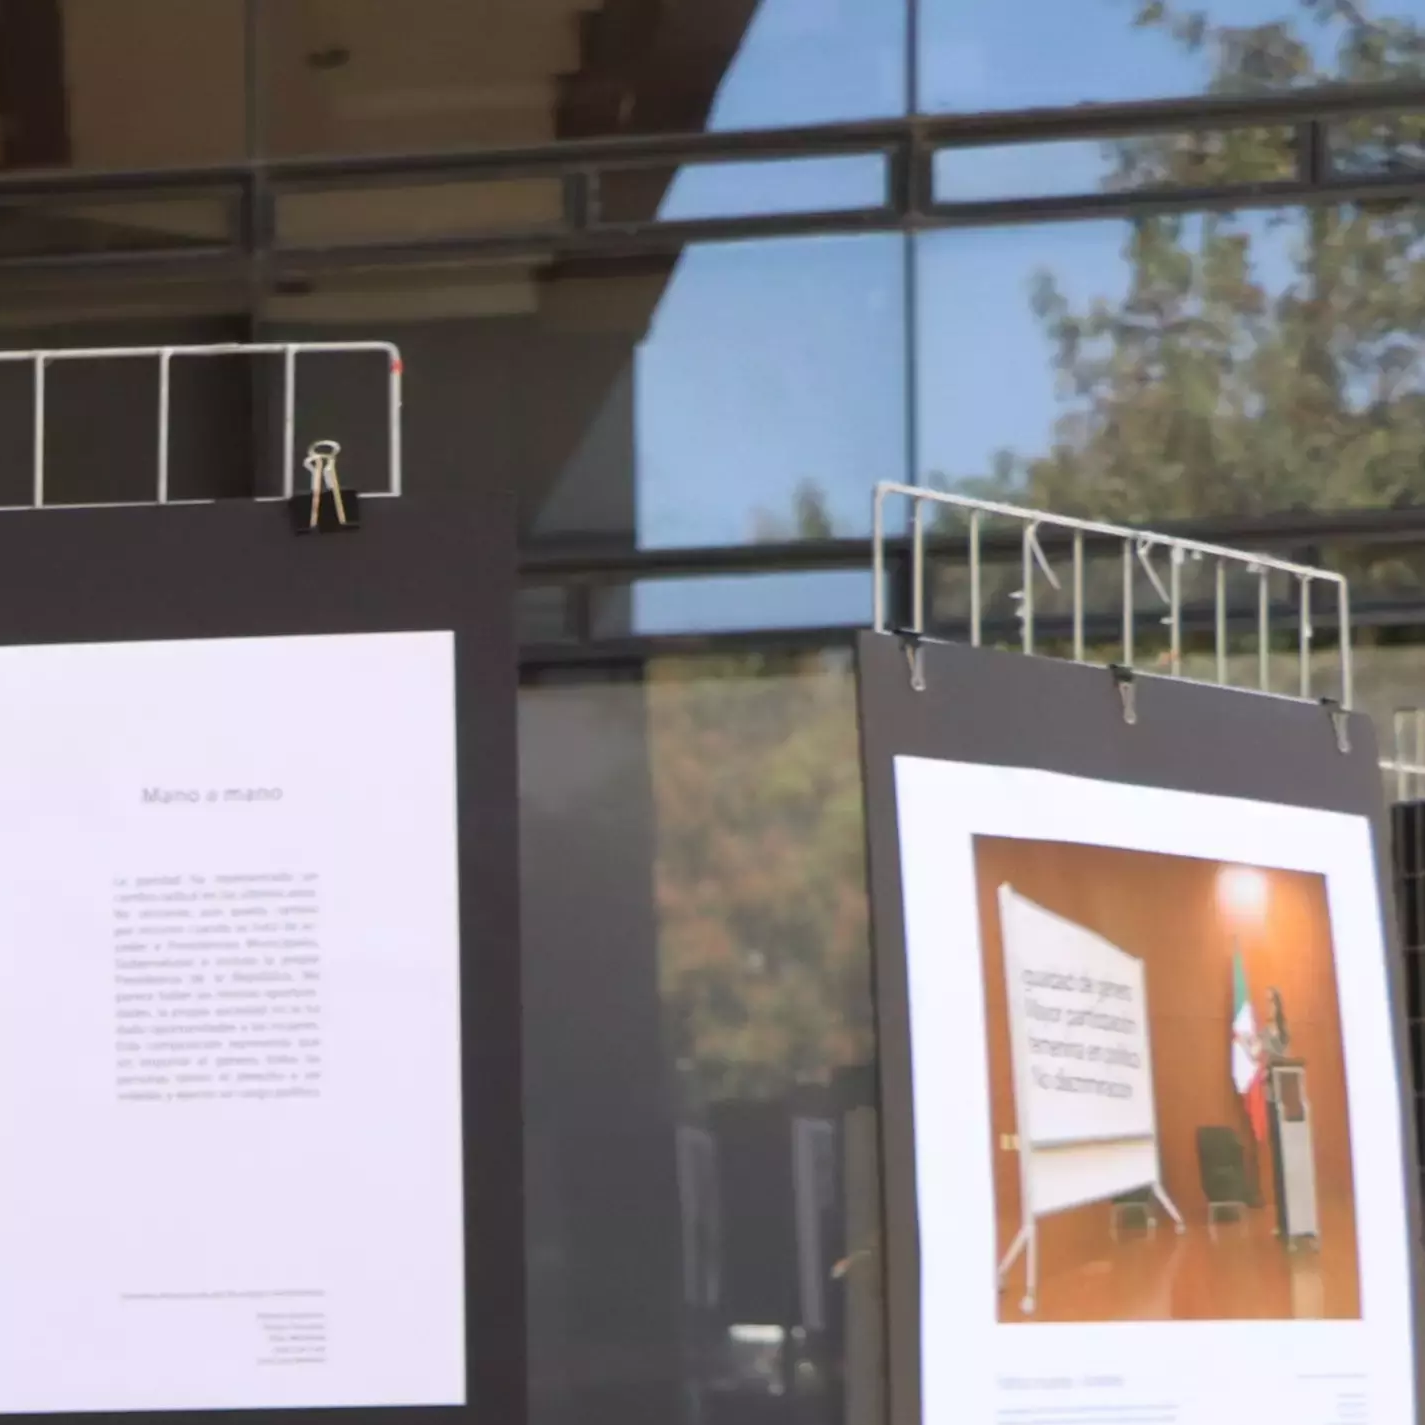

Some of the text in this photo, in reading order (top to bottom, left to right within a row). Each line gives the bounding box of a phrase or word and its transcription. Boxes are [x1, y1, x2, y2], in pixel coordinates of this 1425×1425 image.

[141, 786, 284, 804] Mano a mano
